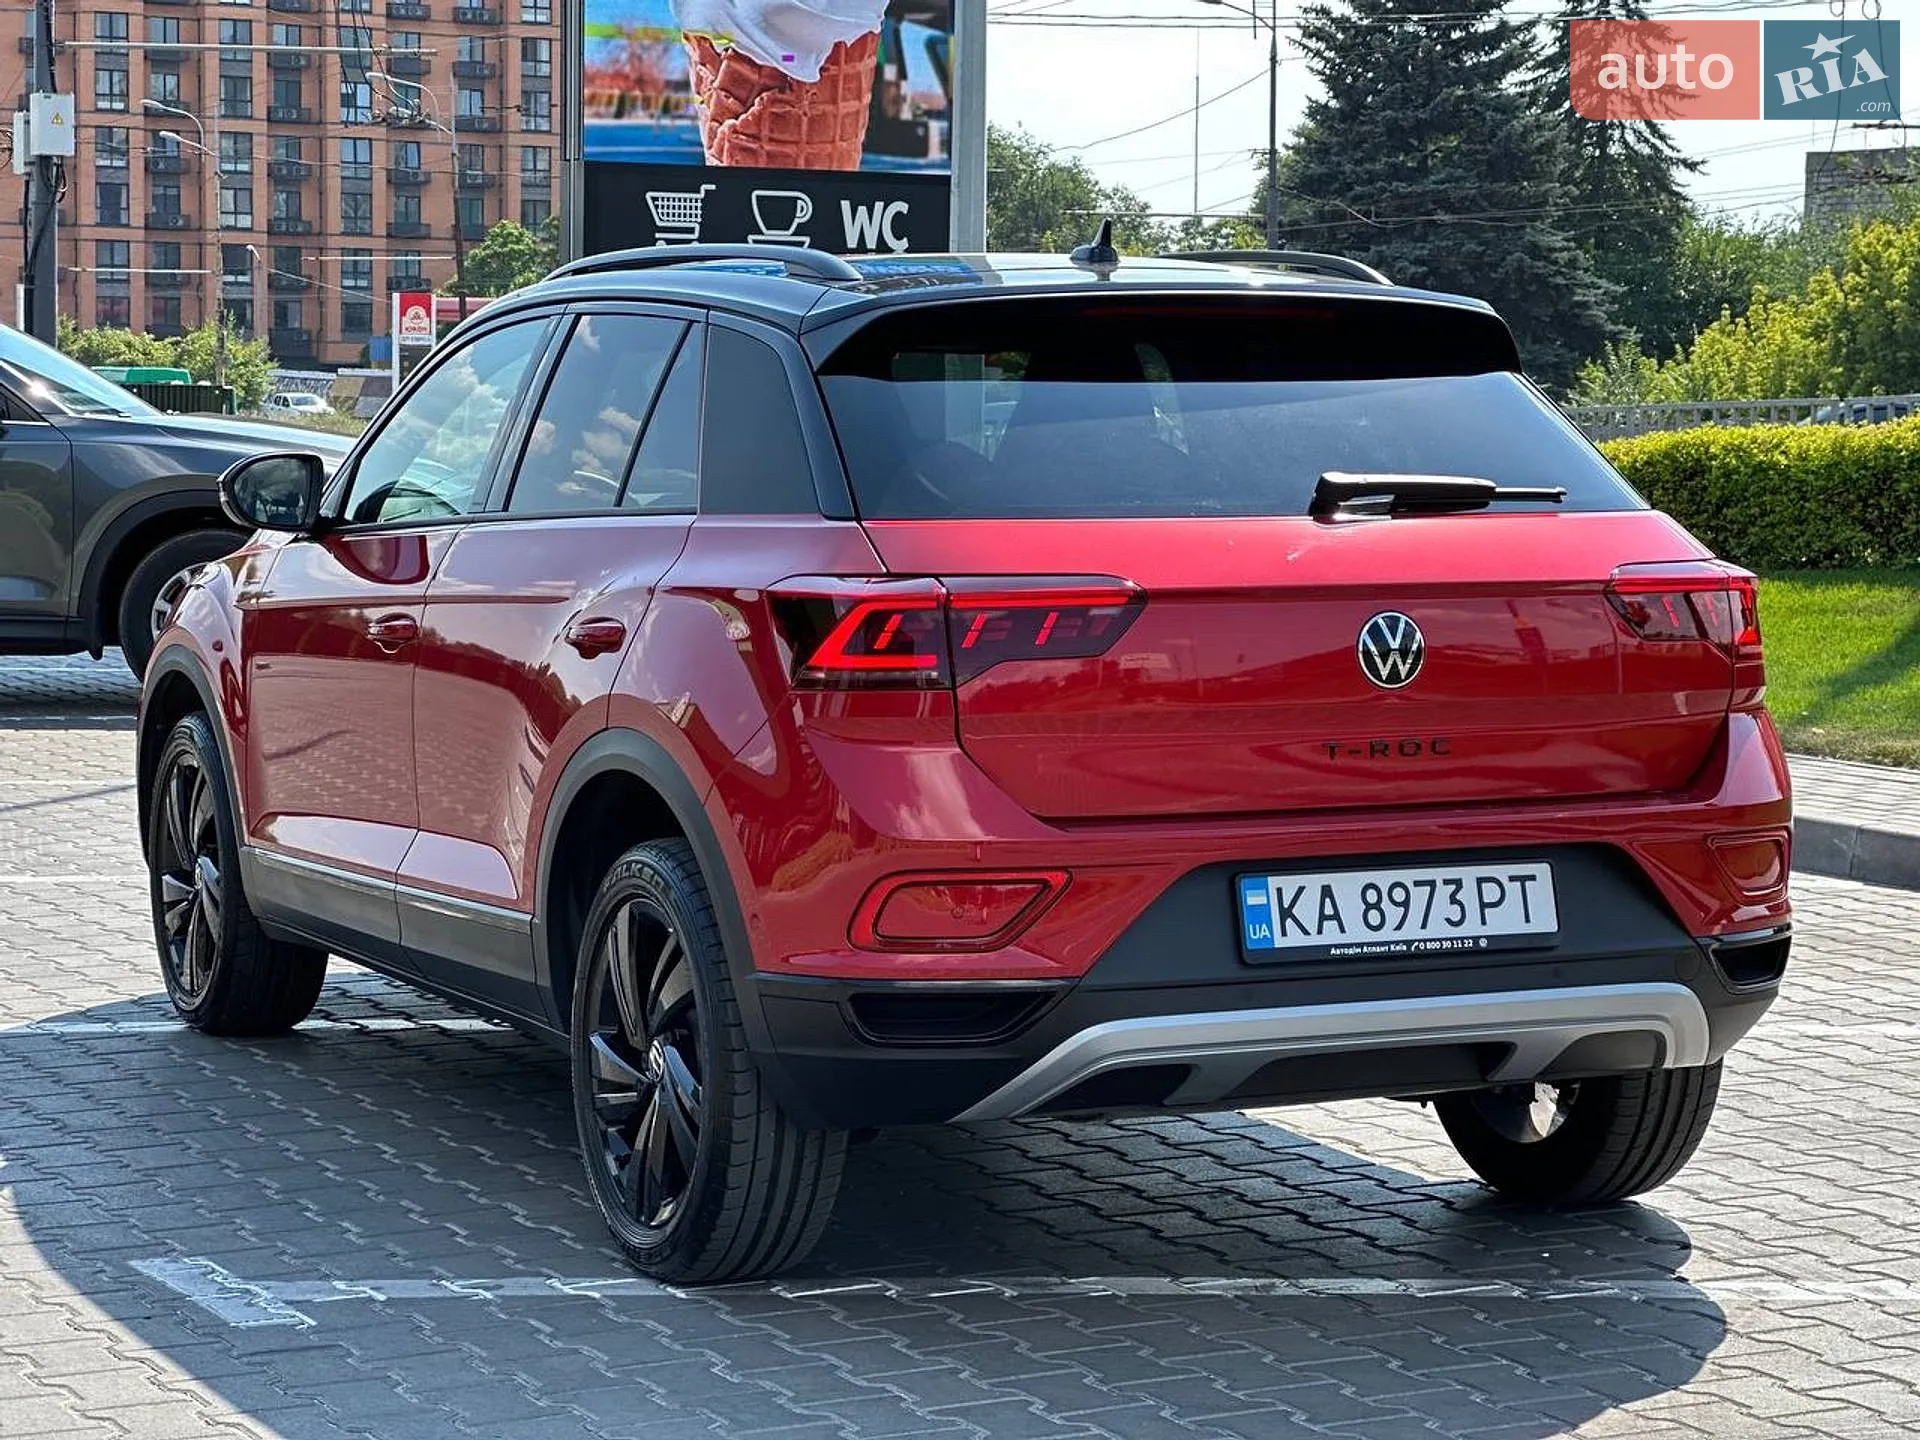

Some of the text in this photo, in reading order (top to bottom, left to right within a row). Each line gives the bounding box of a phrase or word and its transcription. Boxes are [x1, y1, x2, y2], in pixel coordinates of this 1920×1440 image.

[840, 200, 909, 252] WC
[1321, 736, 1452, 761] T-ROC
[1276, 874, 1537, 937] KA 8973 PT
[1249, 923, 1271, 940] UA
[1419, 941, 1425, 950] 0
[1452, 940, 1462, 948] 11
[1464, 938, 1473, 947] 22
